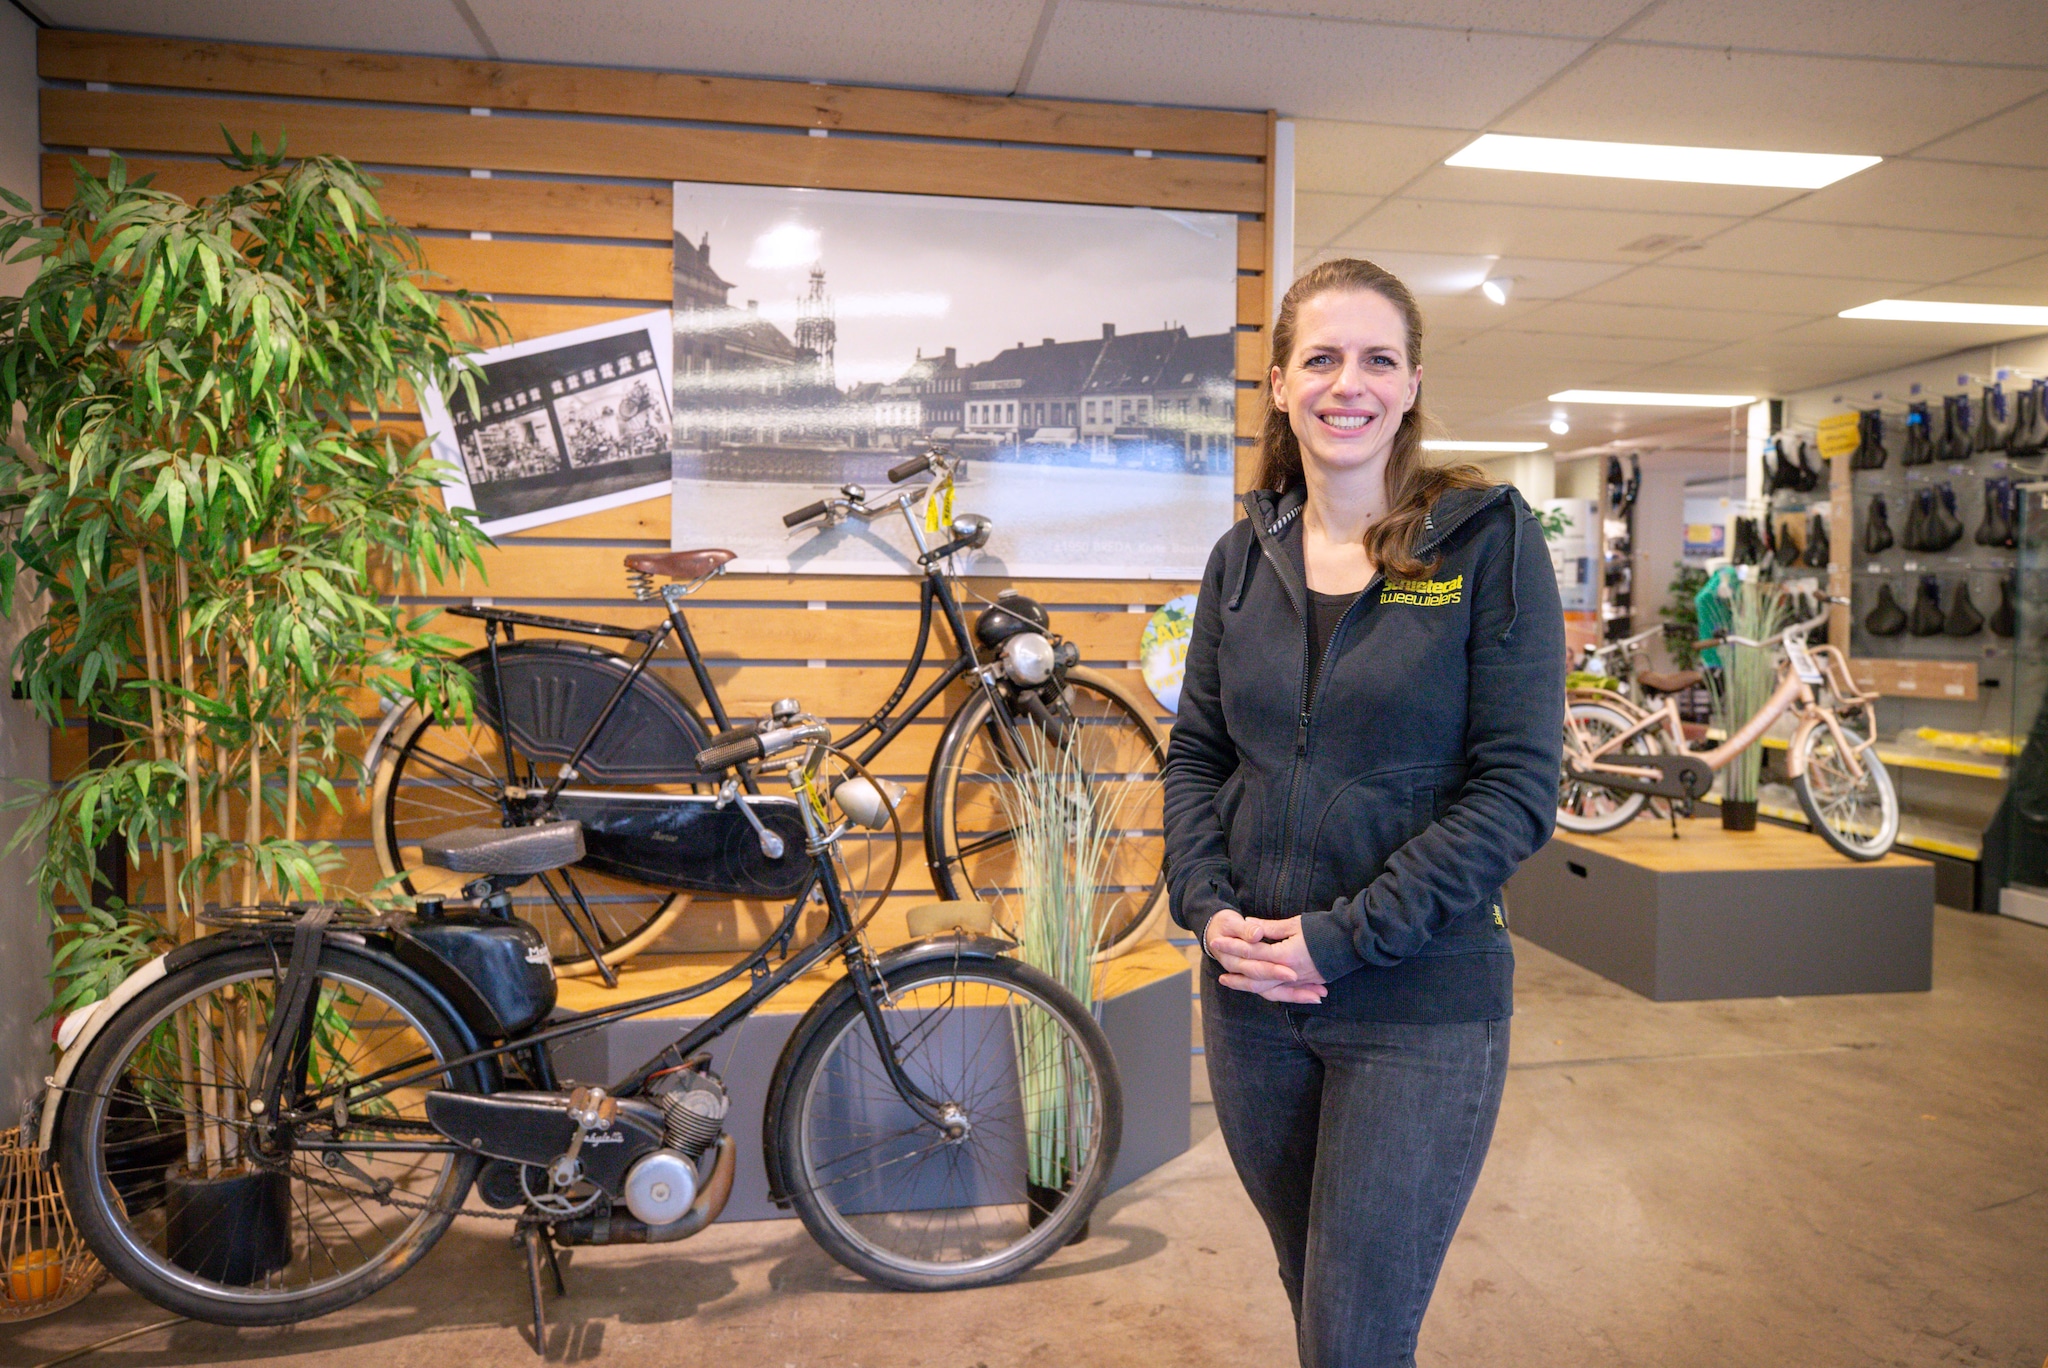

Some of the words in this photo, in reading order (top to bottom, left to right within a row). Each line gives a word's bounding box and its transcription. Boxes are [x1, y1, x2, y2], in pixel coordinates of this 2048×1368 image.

[1092, 540, 1133, 552] BREDA
[1380, 591, 1462, 607] tweewielers
[1157, 620, 1186, 646] AL
